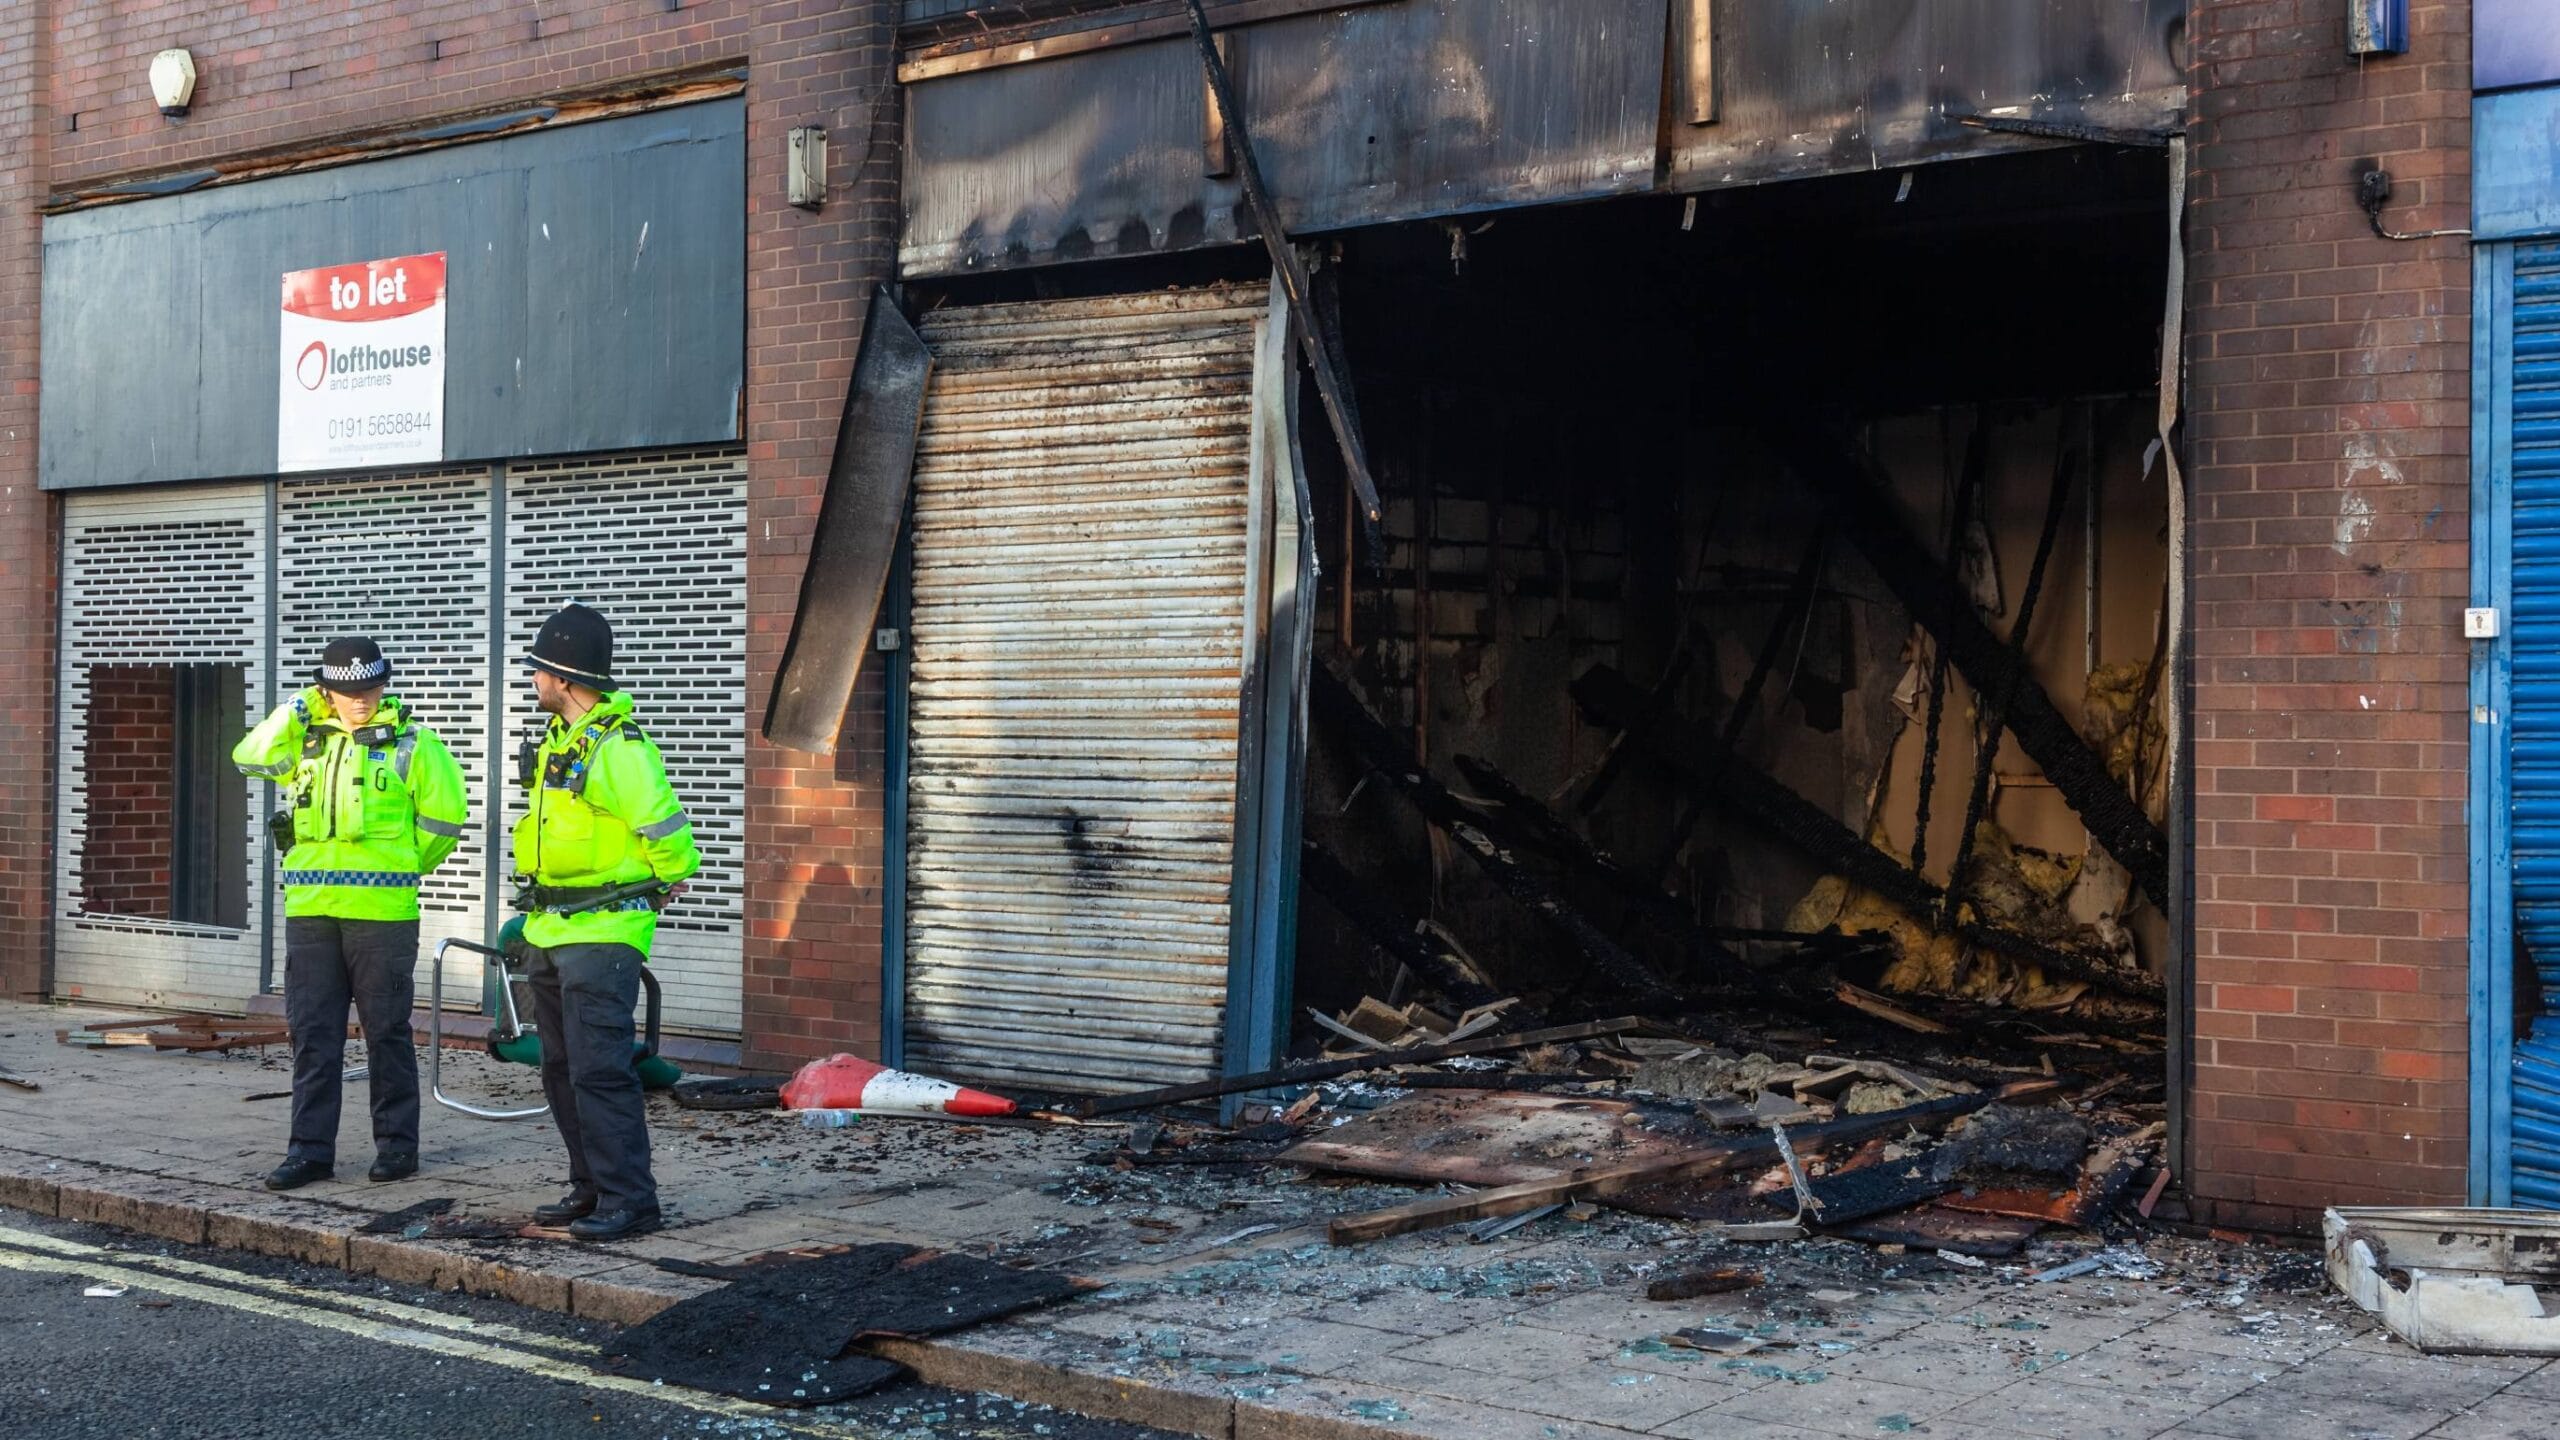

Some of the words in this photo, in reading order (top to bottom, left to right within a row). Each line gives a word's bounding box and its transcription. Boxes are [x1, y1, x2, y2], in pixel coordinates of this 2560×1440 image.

[330, 276, 360, 310] to
[369, 267, 407, 306] let
[330, 344, 431, 374] lofthouse
[330, 376, 348, 391] and
[351, 374, 392, 390] partners
[329, 417, 362, 439] 0191
[368, 411, 431, 436] 5658844
